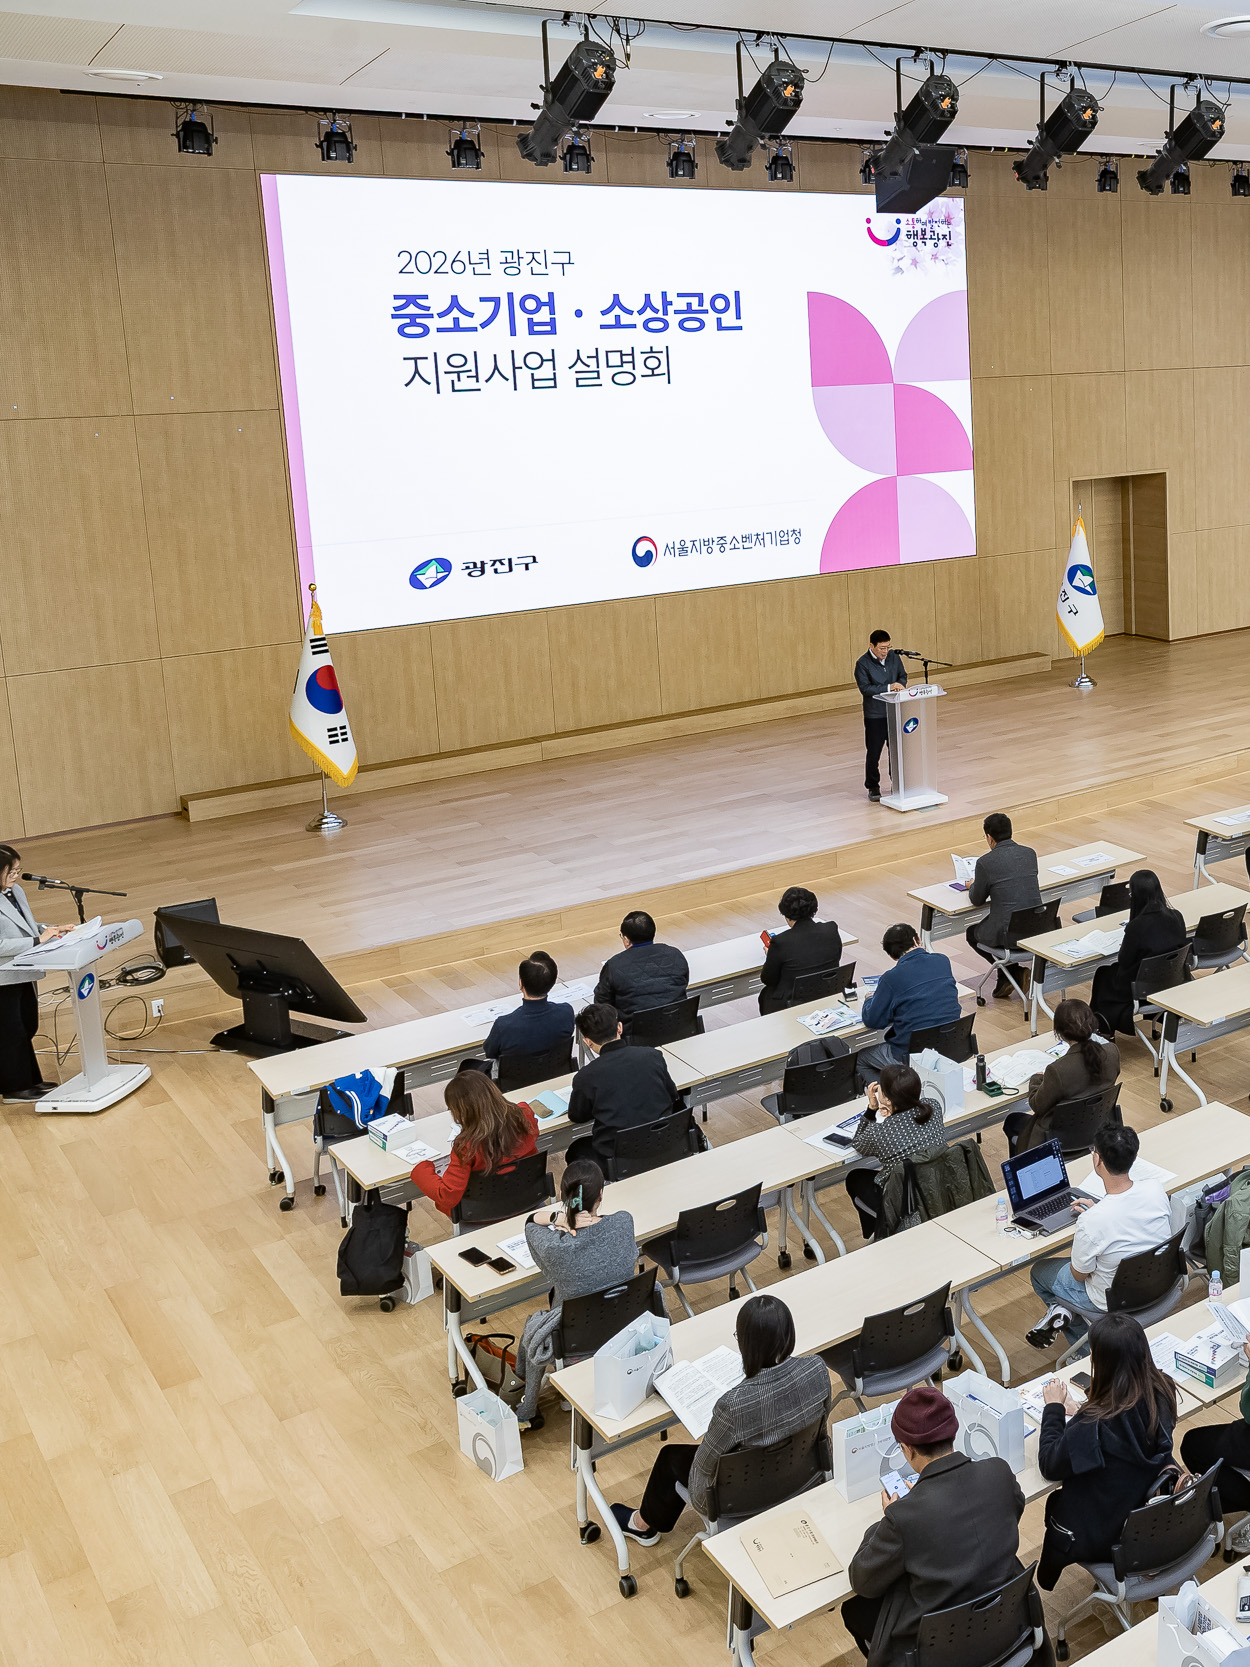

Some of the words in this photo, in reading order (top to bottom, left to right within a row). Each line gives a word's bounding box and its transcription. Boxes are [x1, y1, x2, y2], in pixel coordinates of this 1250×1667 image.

[905, 227, 952, 248] 행복광진
[397, 248, 492, 277] 2026년
[499, 248, 575, 277] 광진구
[390, 291, 558, 339] 중소기업
[599, 290, 744, 334] 소상공인
[402, 348, 558, 395] 지원사업
[567, 345, 673, 388] 설명회
[663, 528, 802, 558] 서울지방중소벤처기업청
[460, 555, 539, 578] 광진구
